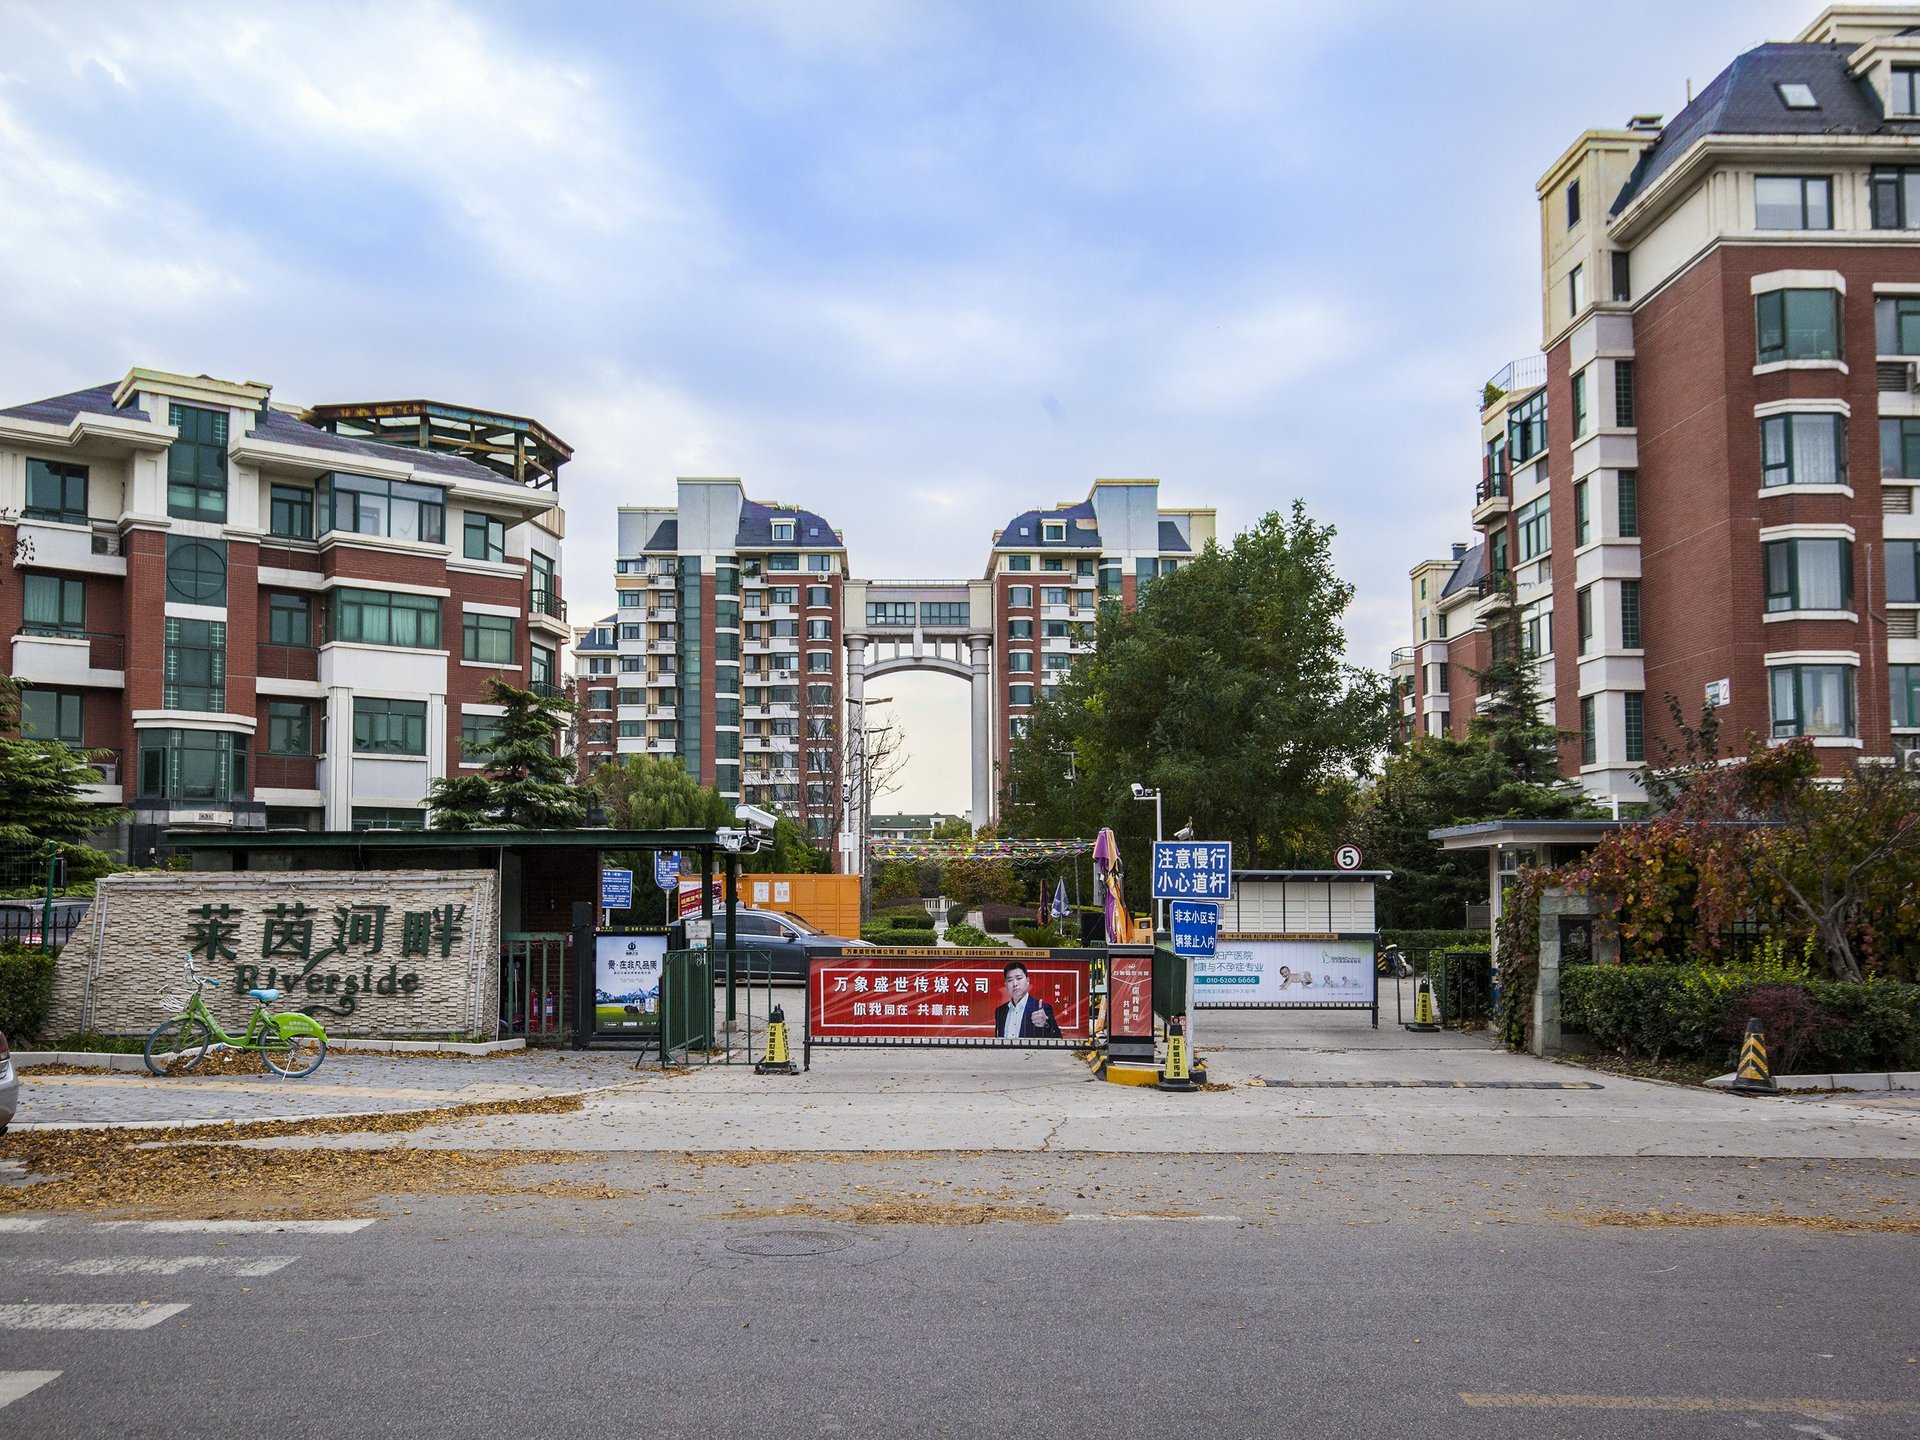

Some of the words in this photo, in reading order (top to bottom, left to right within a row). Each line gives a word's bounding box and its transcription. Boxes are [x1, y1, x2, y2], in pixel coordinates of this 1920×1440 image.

[1158, 848, 1226, 870] 注意慢行
[1342, 850, 1355, 867] 5
[1157, 872, 1226, 894] 小心道杆
[1175, 909, 1216, 925] 非本小区车
[183, 902, 467, 960] 莱茵河畔
[1175, 934, 1215, 949] 辆禁止入内
[235, 964, 420, 995] Riverside
[834, 976, 990, 994] 万象盛世传媒公司
[853, 1002, 909, 1017] 你我同在
[917, 1003, 970, 1017] 共赢未来
